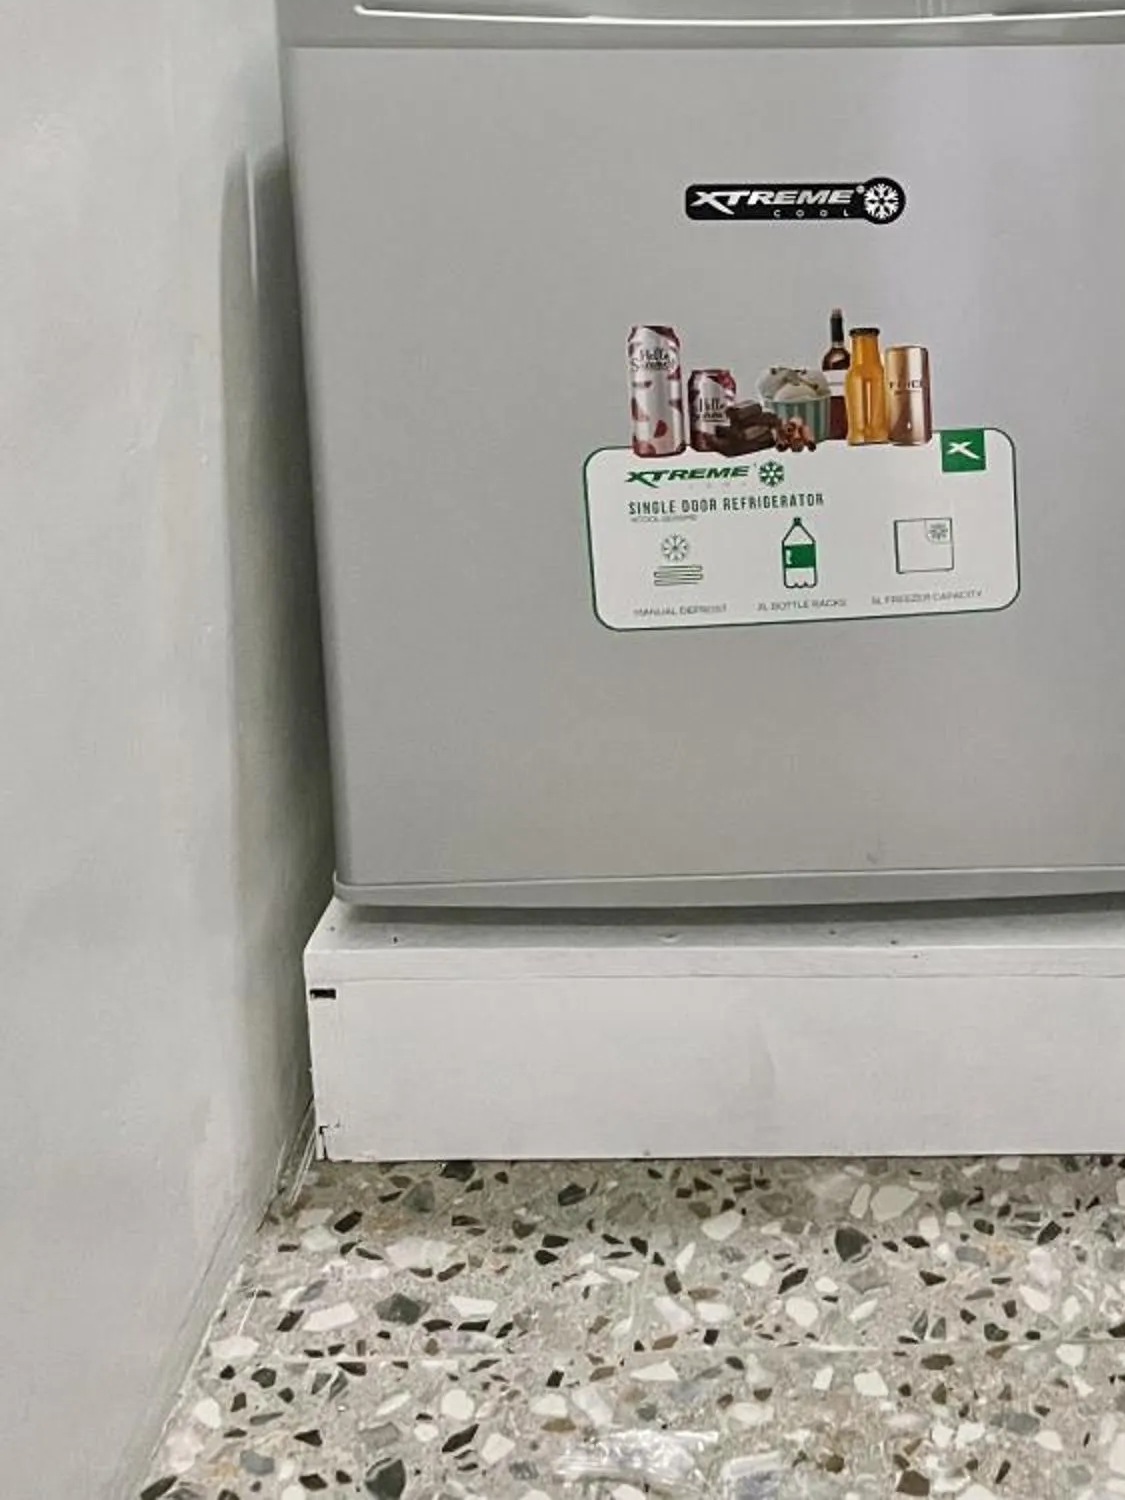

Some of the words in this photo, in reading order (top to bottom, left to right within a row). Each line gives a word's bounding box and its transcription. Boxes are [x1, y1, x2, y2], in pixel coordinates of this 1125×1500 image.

[690, 190, 854, 215] XTREME
[625, 466, 751, 488] XTREME
[629, 500, 676, 515] SINGLE
[682, 498, 717, 513] DOOR
[723, 493, 824, 511] REFRIGERATOR
